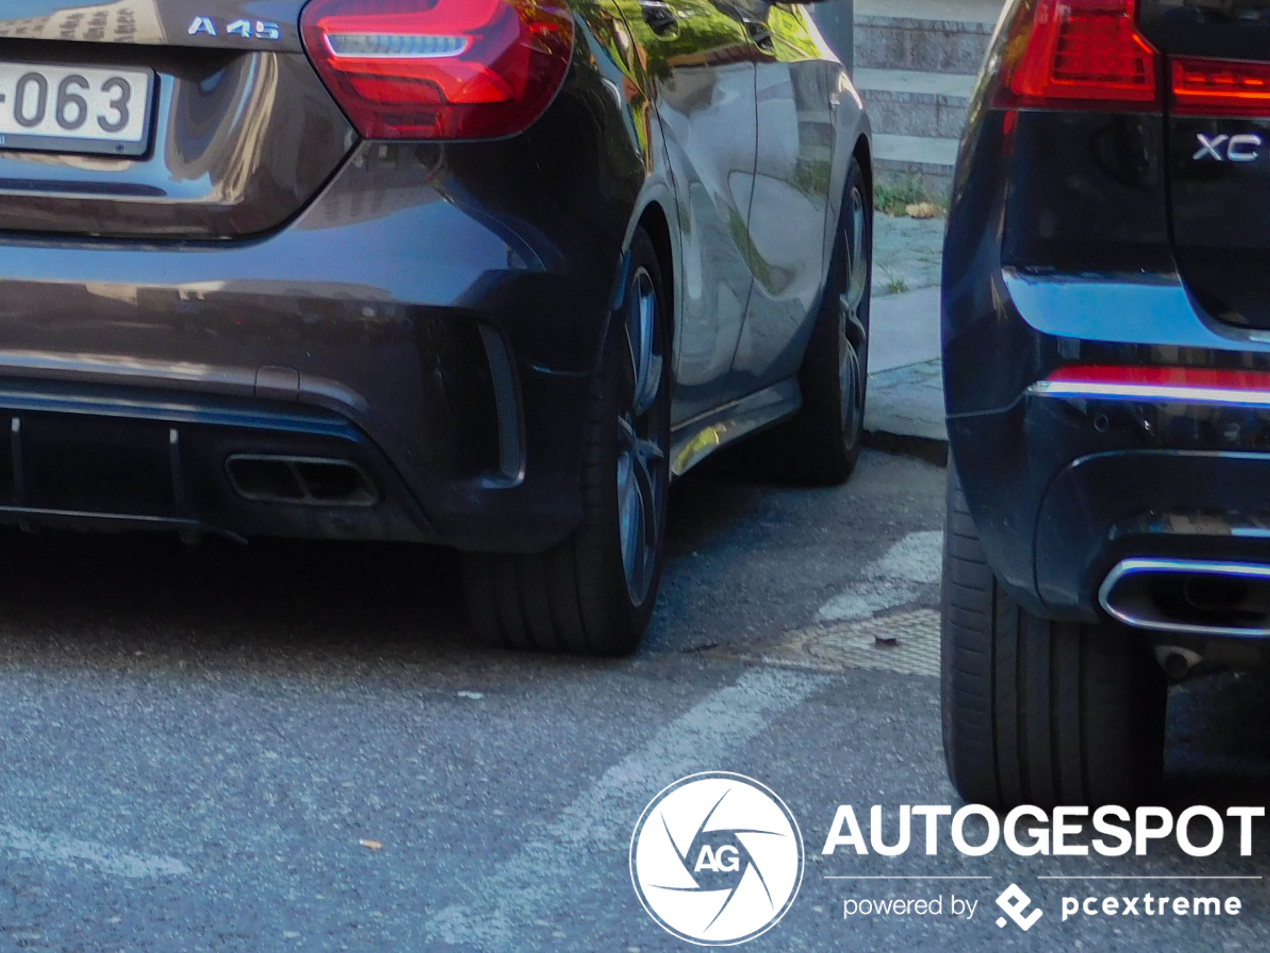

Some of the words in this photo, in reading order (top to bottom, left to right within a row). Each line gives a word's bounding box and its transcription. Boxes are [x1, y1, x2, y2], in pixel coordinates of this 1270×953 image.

[188, 16, 217, 37] A
[226, 19, 280, 40] 45
[1192, 133, 1262, 162] XC
